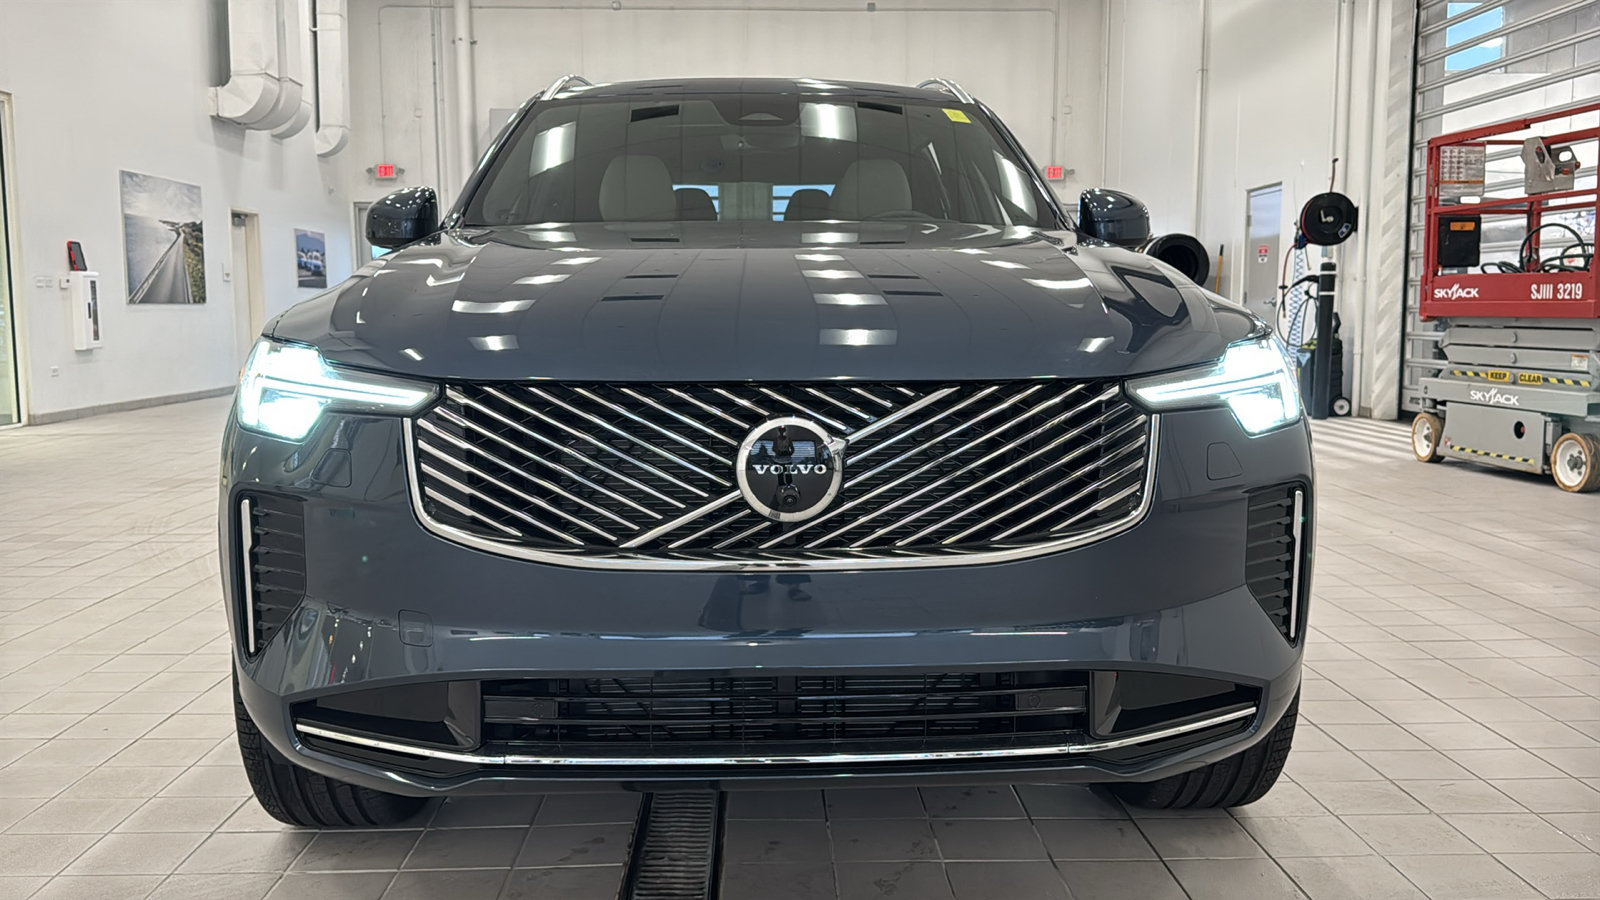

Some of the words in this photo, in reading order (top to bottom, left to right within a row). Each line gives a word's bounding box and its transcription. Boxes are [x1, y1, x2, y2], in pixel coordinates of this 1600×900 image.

[1047, 166, 1062, 178] EXIT
[1433, 283, 1479, 300] SKYJACK
[1530, 283, 1553, 300] SJIII
[1557, 282, 1583, 299] 3219
[1490, 371, 1507, 380] KEEP
[1519, 373, 1542, 384] CLEAR
[1470, 388, 1519, 405] SKYJACK
[752, 464, 827, 475] VOLVO
